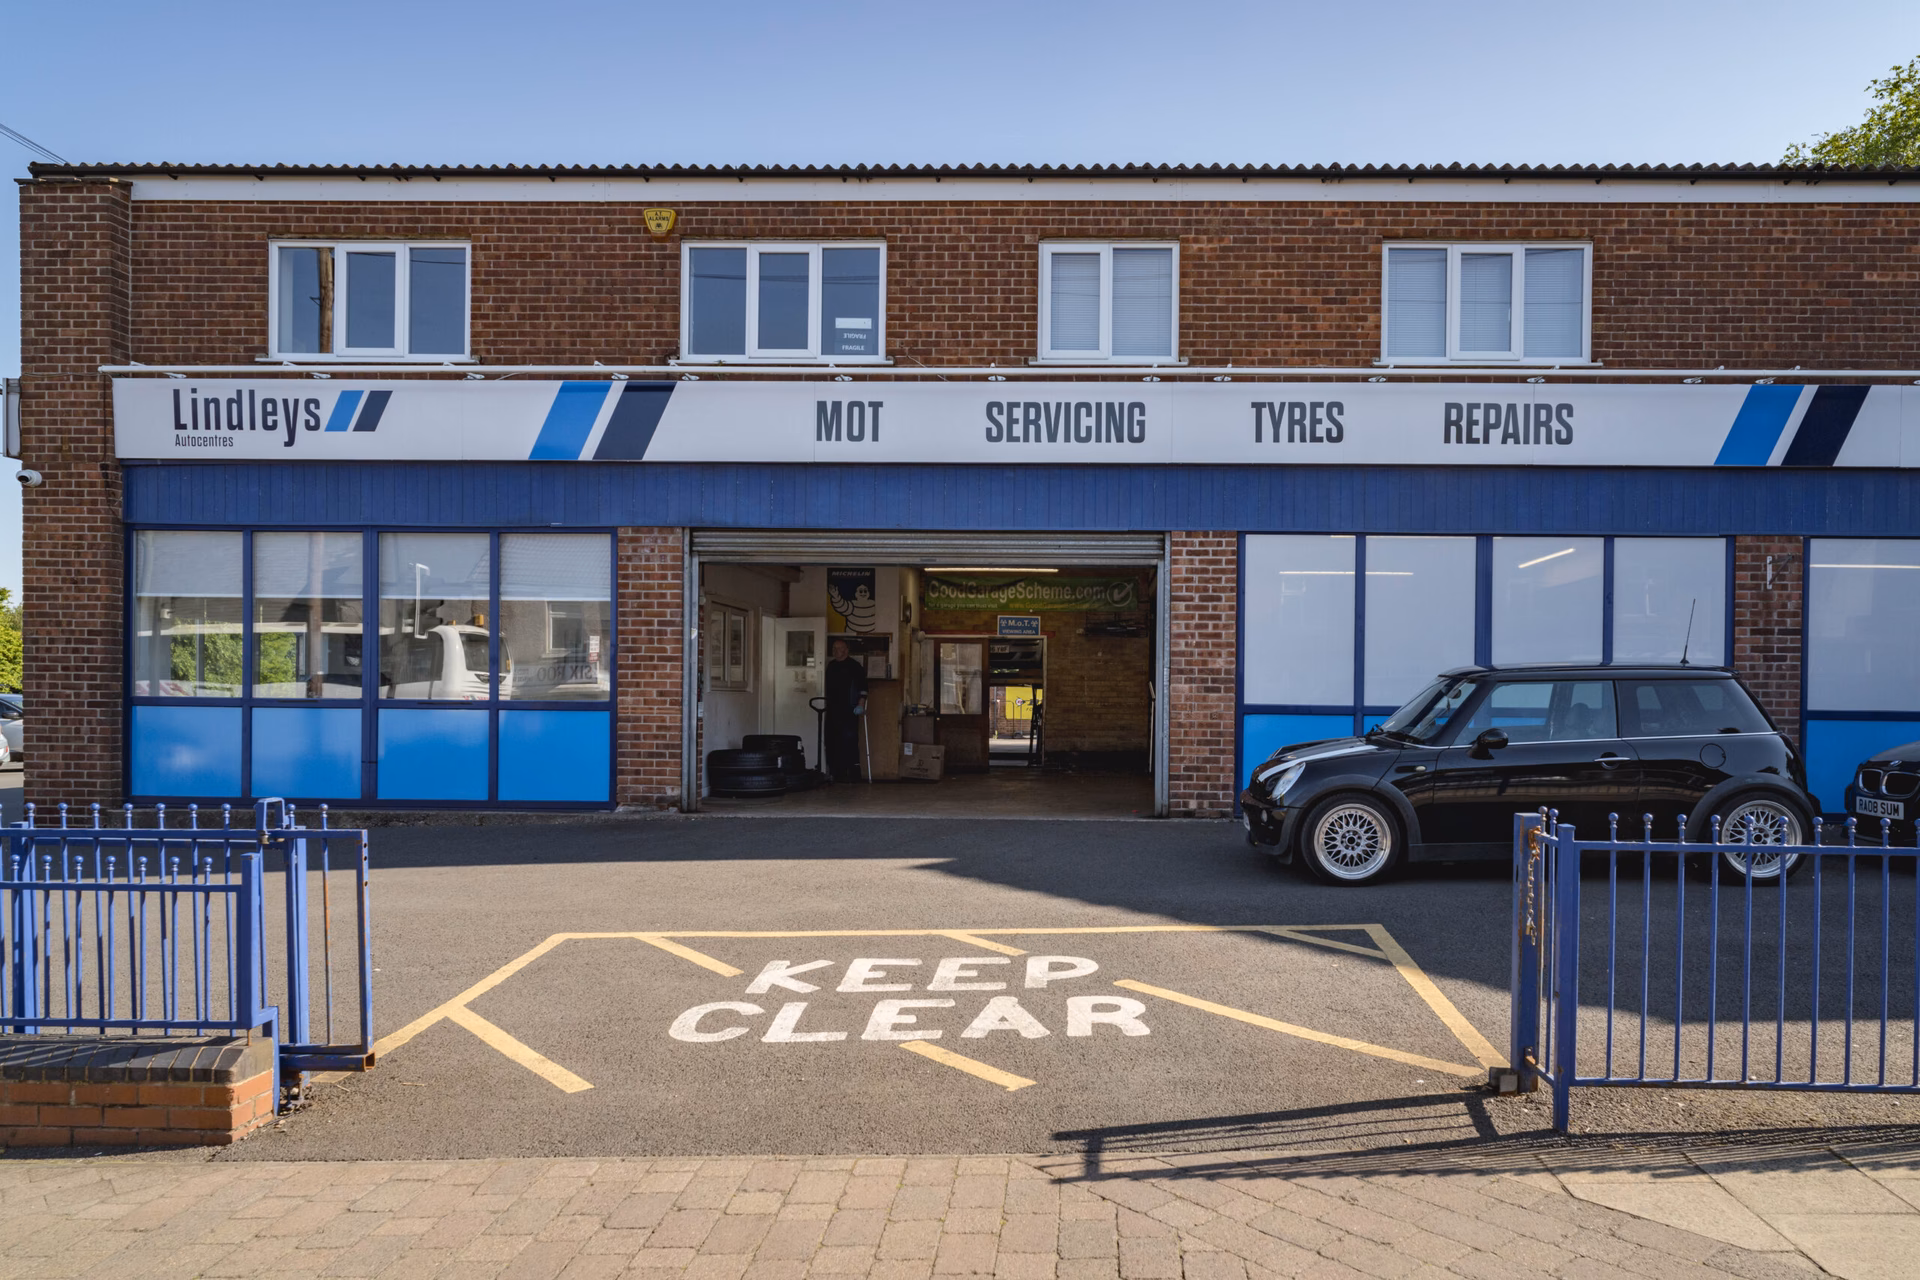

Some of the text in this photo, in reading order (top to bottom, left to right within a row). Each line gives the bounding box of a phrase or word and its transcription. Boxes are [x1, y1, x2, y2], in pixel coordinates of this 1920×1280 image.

[843, 332, 867, 340] FRAGILE
[172, 387, 321, 448] Lindleys
[816, 400, 1574, 446] MOT SERVICING TYRES REPAIRS
[175, 434, 234, 447] Autocentres
[928, 580, 1106, 602] GoodGarageScheme.com
[1858, 799, 1899, 816] RA08 SUM
[745, 956, 1099, 994] KEEP
[668, 996, 1152, 1042] CLEAR
